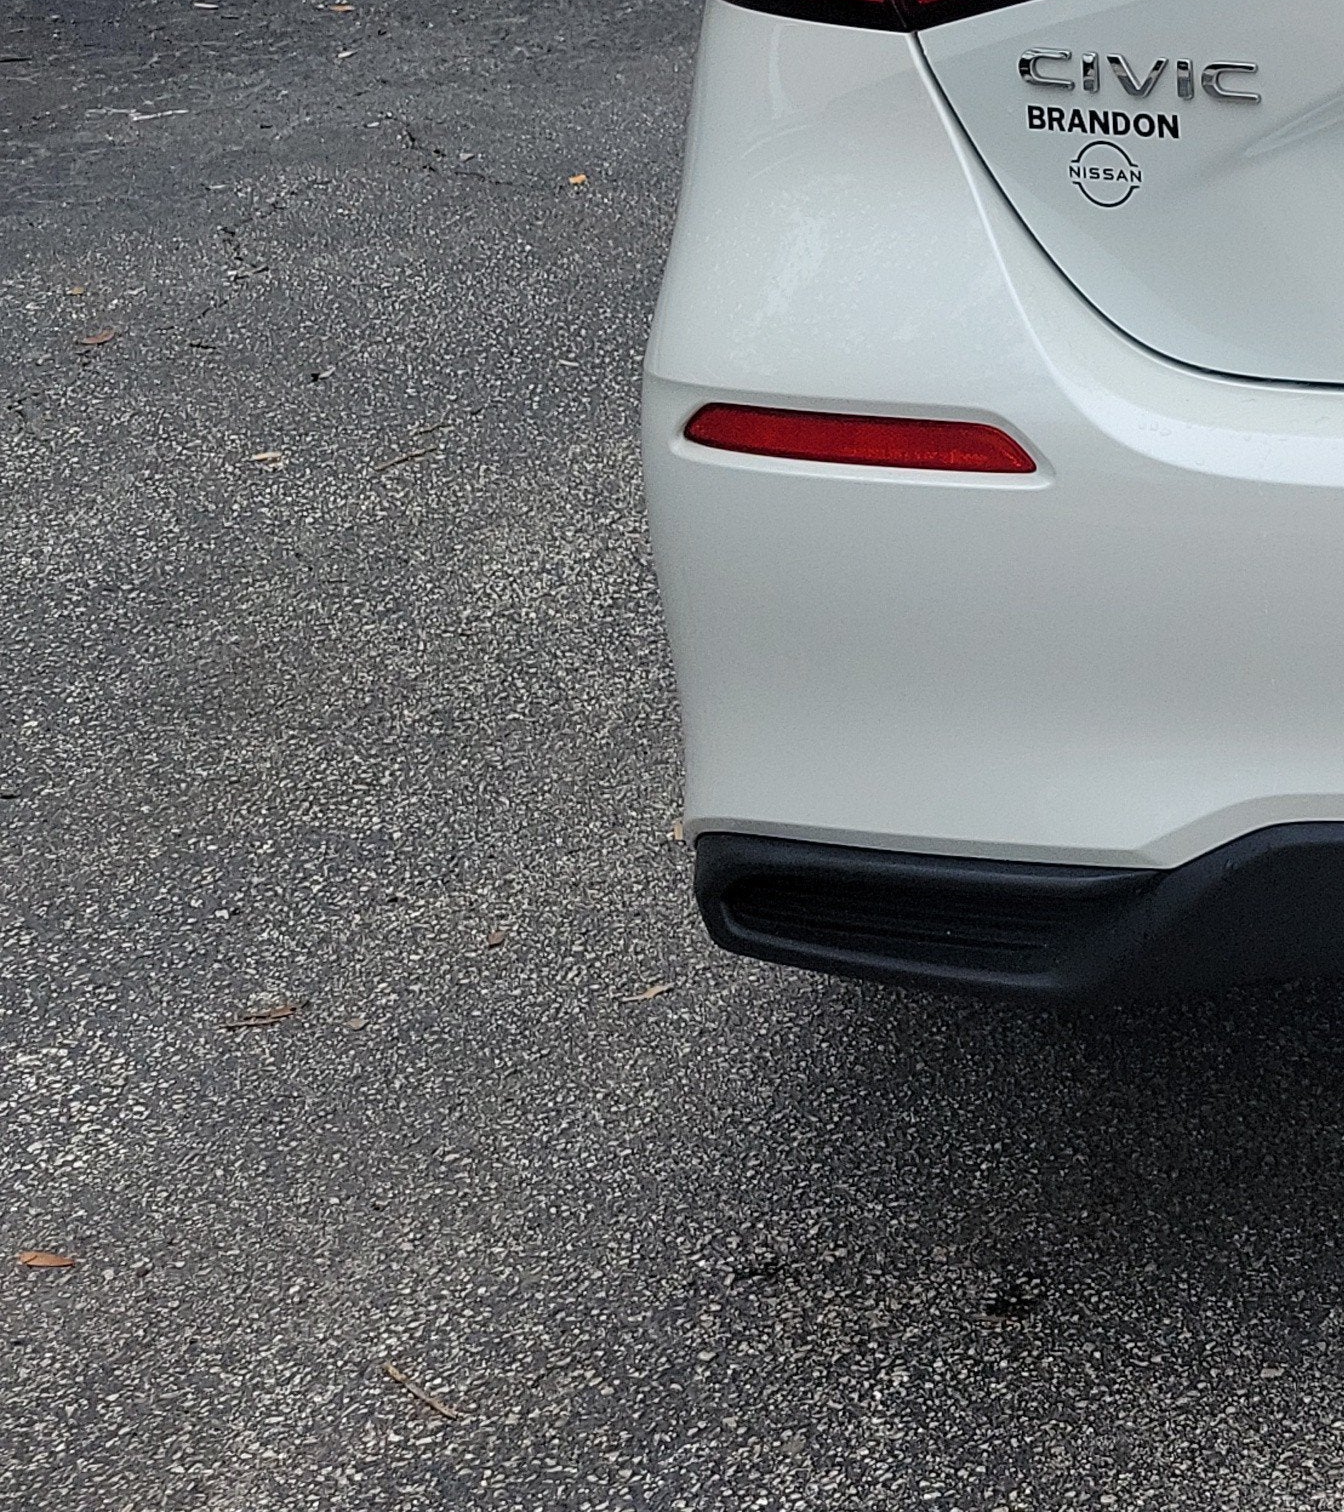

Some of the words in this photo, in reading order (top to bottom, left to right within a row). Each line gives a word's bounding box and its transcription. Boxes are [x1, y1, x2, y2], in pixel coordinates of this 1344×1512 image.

[1018, 46, 1262, 104] CIVIC
[1026, 104, 1180, 139] BRANDON
[1069, 164, 1142, 183] NISSAN
